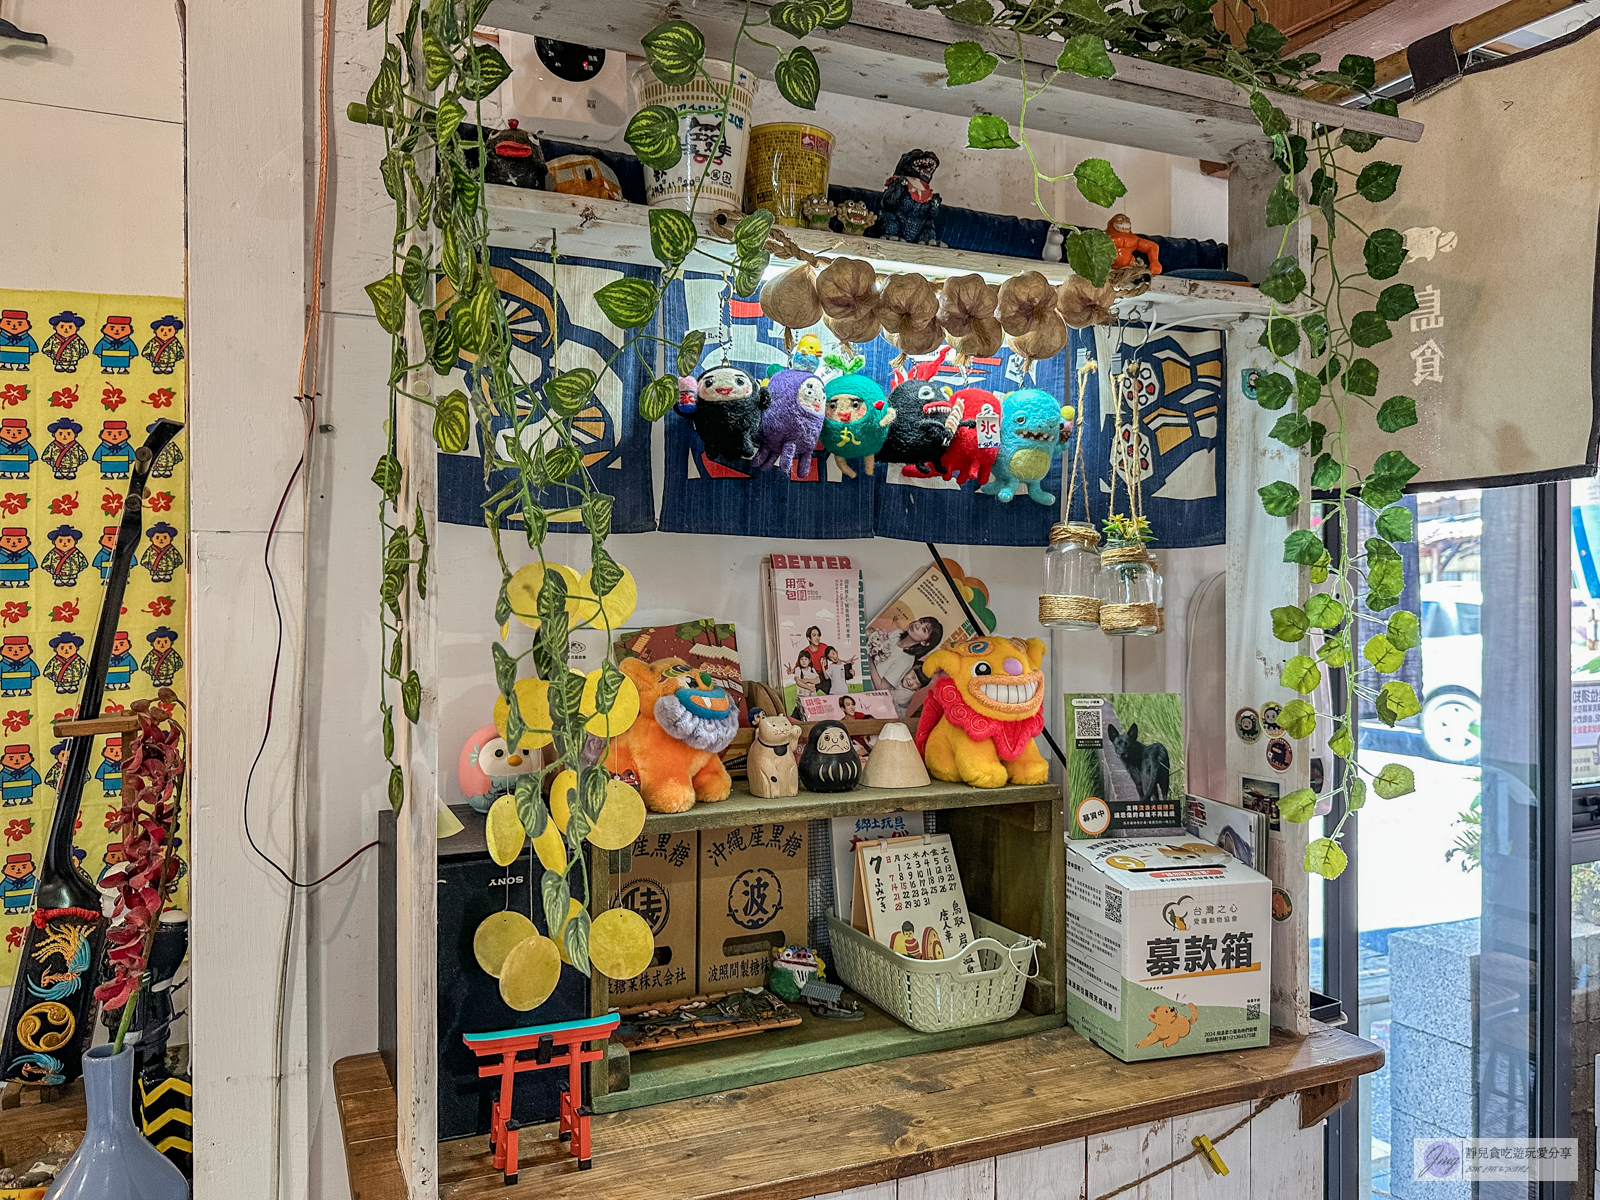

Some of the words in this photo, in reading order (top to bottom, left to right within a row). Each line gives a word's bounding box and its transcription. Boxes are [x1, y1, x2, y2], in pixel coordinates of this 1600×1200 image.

[772, 554, 852, 569] BETTER
[786, 578, 806, 588] 用愛
[912, 851, 920, 859] 水
[921, 850, 929, 858] 木
[934, 857, 939, 865] 5
[908, 872, 912, 880] 9
[917, 870, 923, 878] 10
[926, 868, 932, 876] 11
[935, 866, 942, 874] 12
[488, 876, 524, 887] SONY
[920, 879, 926, 887] 17
[928, 877, 935, 885] 18
[938, 875, 944, 883] 19
[742, 877, 769, 916] 波
[894, 893, 900, 901] 21
[903, 891, 910, 899] 22
[921, 888, 929, 896] 24
[930, 886, 937, 894] 25
[949, 883, 956, 891] 27
[895, 903, 902, 911] 28
[905, 901, 911, 909] 29
[913, 899, 921, 907] 30
[924, 898, 930, 906] 31
[1193, 903, 1238, 916] 台灣之心
[952, 900, 966, 927] 鳥取
[1193, 915, 1237, 925] 愛護動物協會
[1146, 931, 1254, 976] 募款箱
